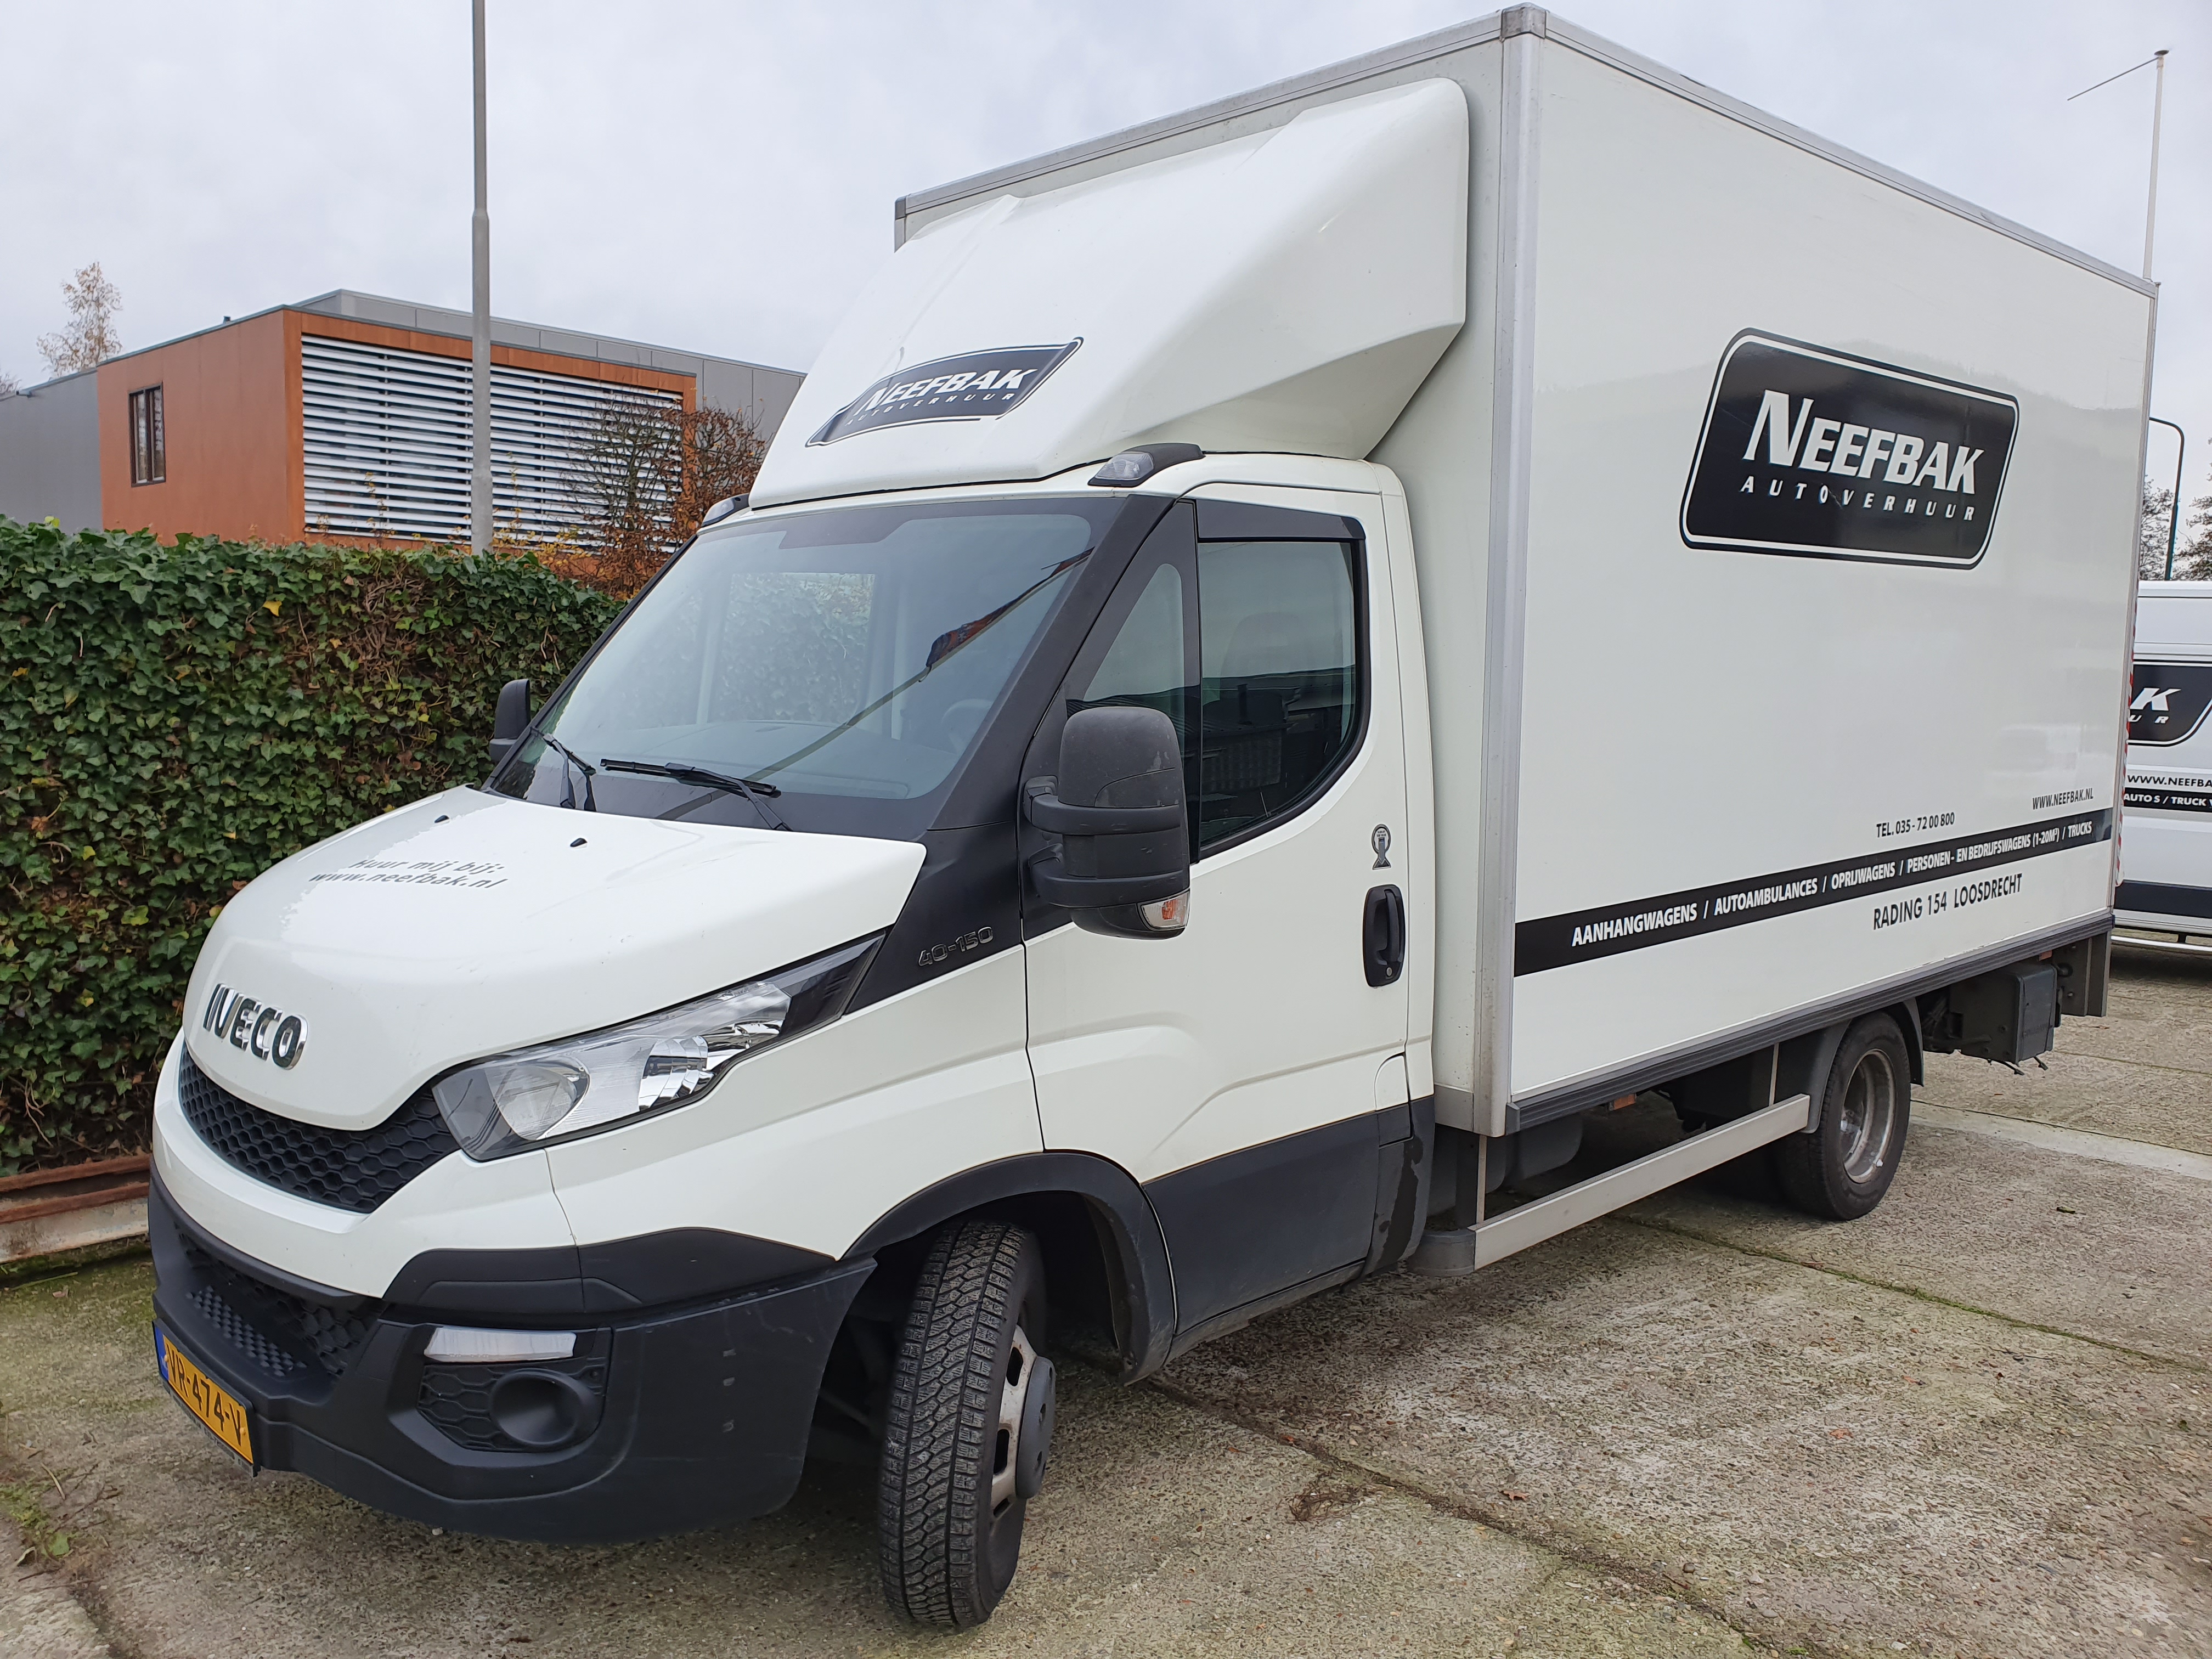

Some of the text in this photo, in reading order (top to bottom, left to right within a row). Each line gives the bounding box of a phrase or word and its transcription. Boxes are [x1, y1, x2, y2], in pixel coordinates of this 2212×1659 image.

[845, 393, 1015, 426] AUTOVERHUUR
[853, 369, 1038, 417] NEEFBAK
[1743, 389, 1984, 494] NEEFBAK
[1740, 476, 1974, 521] AUTOVERHUUR
[2032, 788, 2094, 810] WWW.NEEFBAK.NL
[2171, 797, 2207, 806] TRUCK
[1876, 822, 1894, 838] TEL.
[1895, 819, 1911, 834] 035
[1917, 816, 1927, 831] 72
[1929, 815, 1939, 828] 00
[1940, 811, 1955, 827] 800
[308, 873, 508, 888] www.neefbak.nl
[407, 860, 459, 872] mij
[453, 862, 505, 874] bij:
[1571, 902, 1697, 947] AANHANGWAGENS
[1713, 878, 1818, 916] AUTOAMBULANCES
[1831, 862, 1895, 889] OPRIJWAGENS
[1906, 850, 1955, 873] PERSONEN-
[1956, 847, 1968, 863] EN
[1968, 833, 2031, 860] BEDRIJFSWAGENS
[2068, 821, 2092, 838] TRUCKS
[1874, 873, 2023, 930] RADING 154 LOOSDRECHT
[918, 926, 994, 967] 40-150
[202, 983, 308, 1071] IVECO
[166, 1344, 241, 1446] VR-474-V
